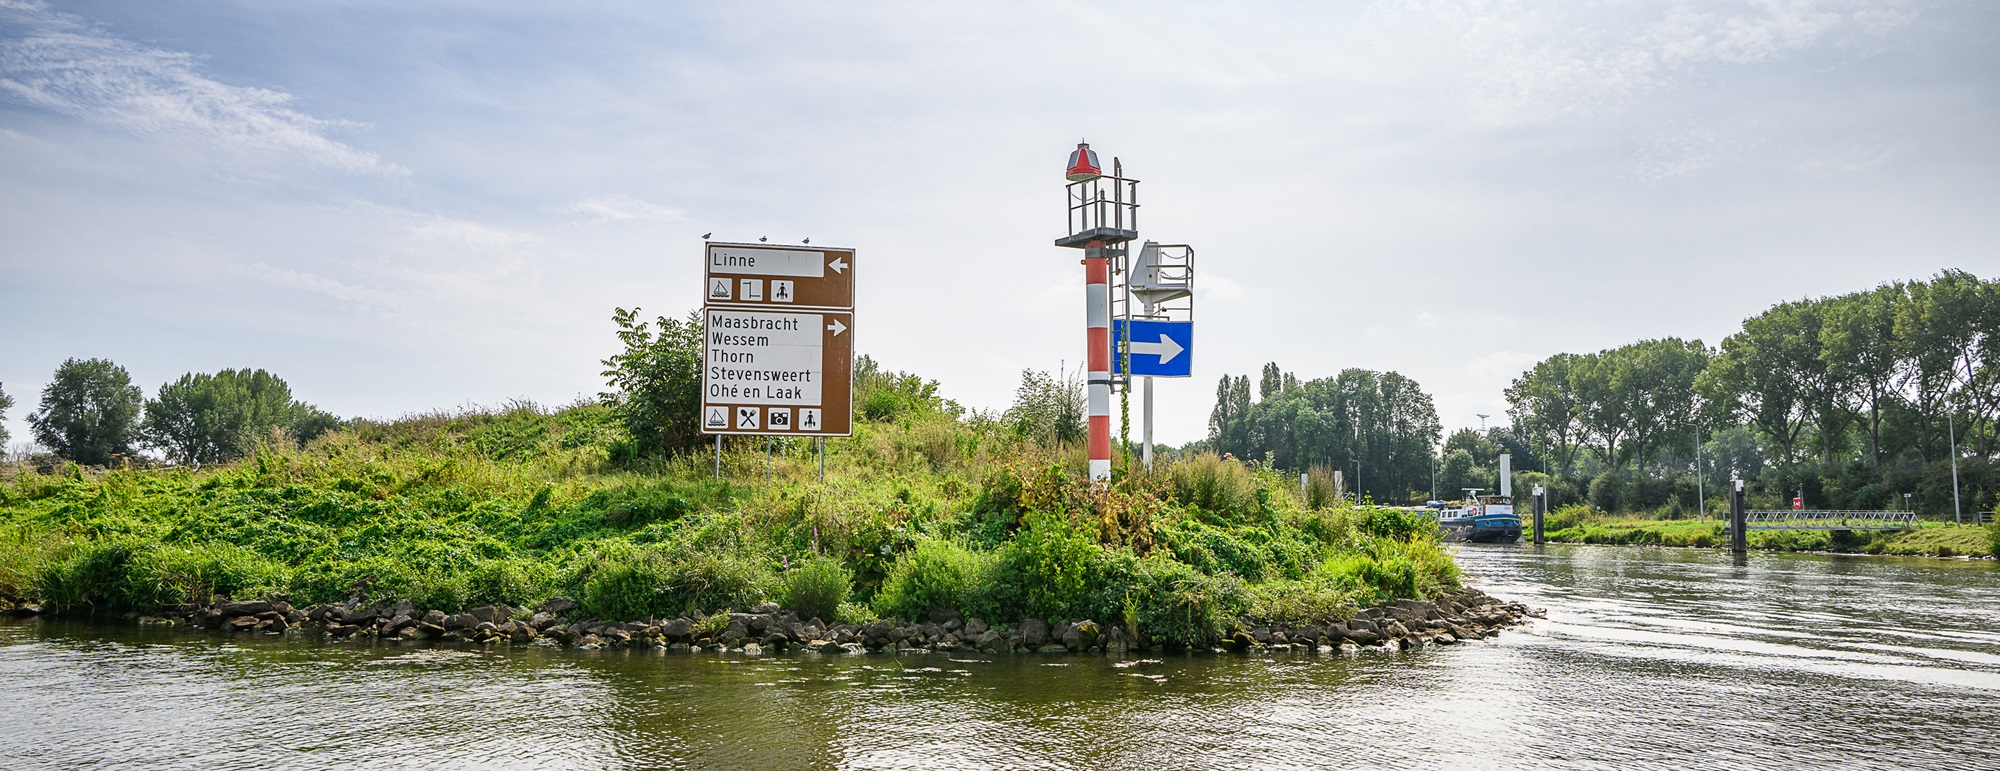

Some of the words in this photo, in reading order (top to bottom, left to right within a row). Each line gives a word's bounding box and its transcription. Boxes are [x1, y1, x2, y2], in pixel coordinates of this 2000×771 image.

[714, 252, 755, 267] Linne
[712, 315, 798, 331] Maasbracht
[712, 332, 768, 347] Wessem
[712, 349, 753, 363] Thorn
[711, 366, 811, 382] Stevensweert
[710, 383, 738, 398] Ohé
[743, 387, 760, 398] en
[767, 385, 801, 399] Laak
